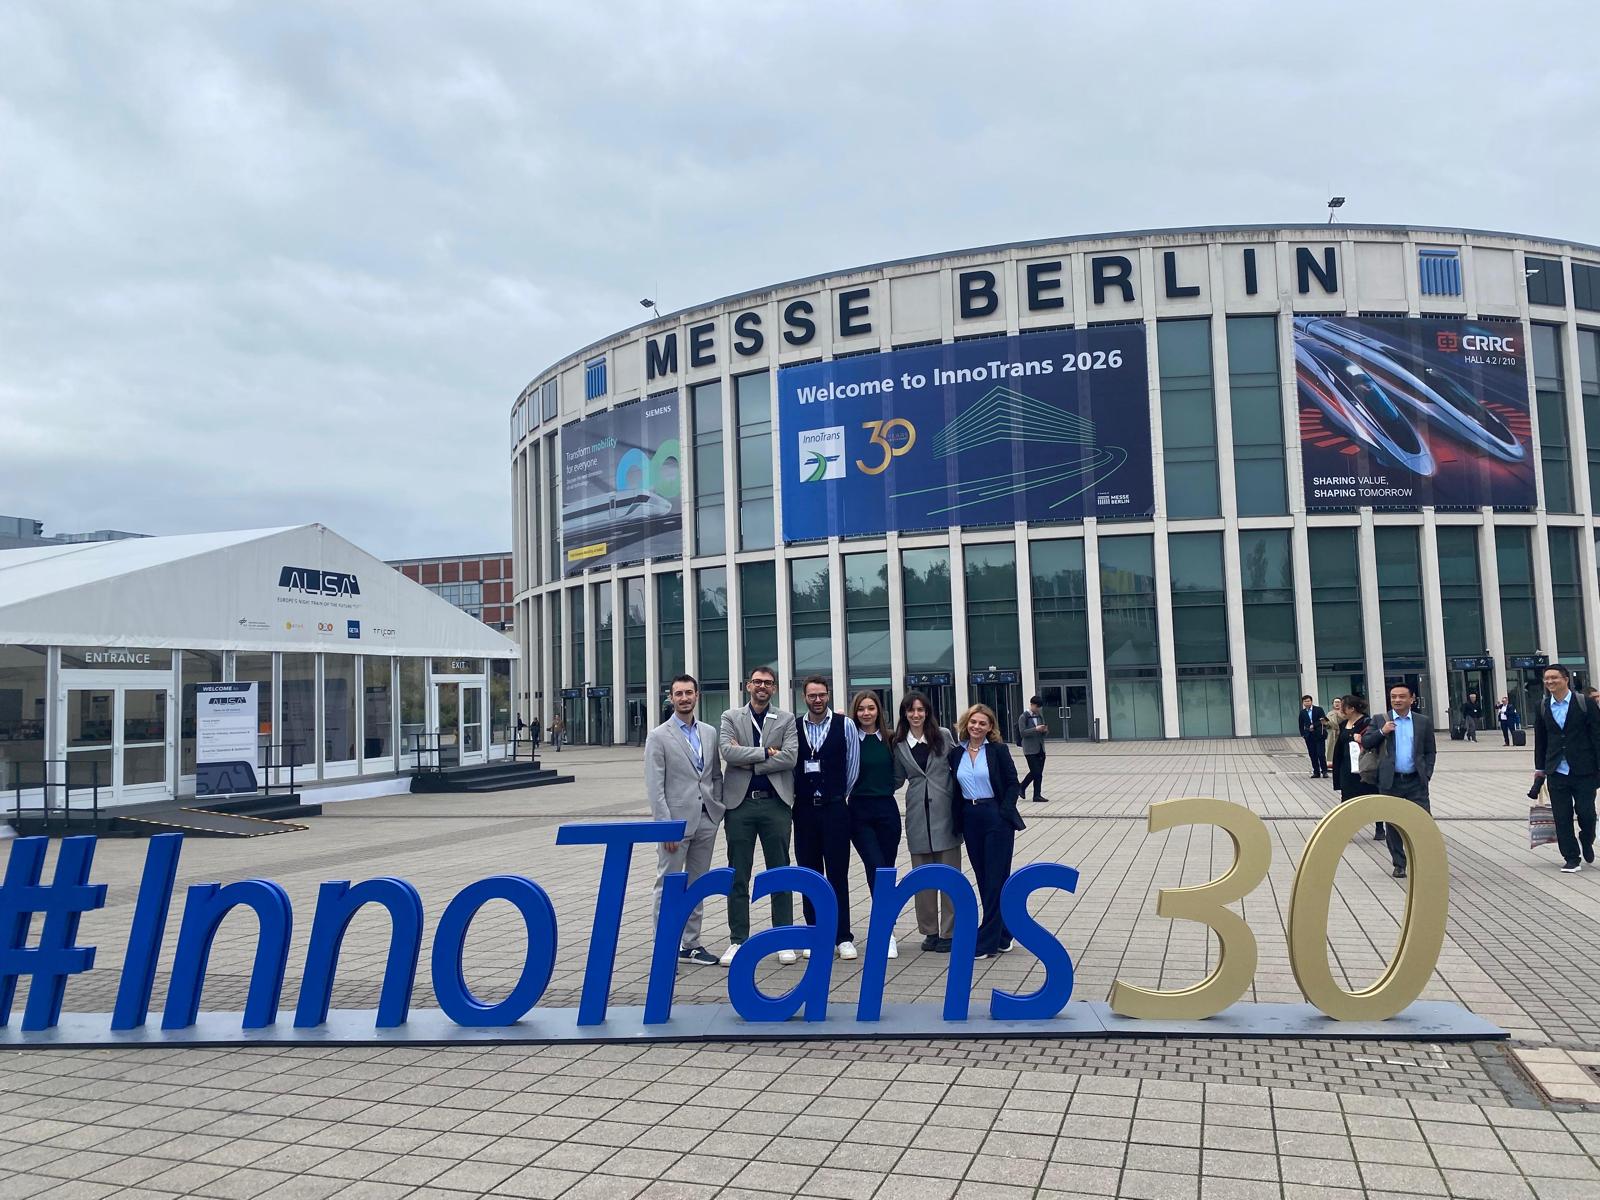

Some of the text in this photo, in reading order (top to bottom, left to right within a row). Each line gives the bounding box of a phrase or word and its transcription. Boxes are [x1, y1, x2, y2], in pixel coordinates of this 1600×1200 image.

[647, 247, 1338, 379] MESSE BERLIN
[1462, 335, 1515, 352] CRRC
[1464, 356, 1485, 364] HALL
[797, 349, 1123, 405] Welcome to InnoTrans 2026
[645, 405, 672, 418] SIEMENS
[803, 431, 841, 444] InnoTrans
[566, 437, 618, 460] Transform mobility
[856, 418, 916, 475] 30
[566, 458, 598, 474] for everyone
[1313, 476, 1389, 486] SHARING VALUE,
[1314, 488, 1413, 498] SHAPING TOMORROW
[85, 652, 150, 664] ENTRANCE
[451, 661, 465, 669] EXIT
[0, 794, 1450, 1031] #InnoTrans 30
